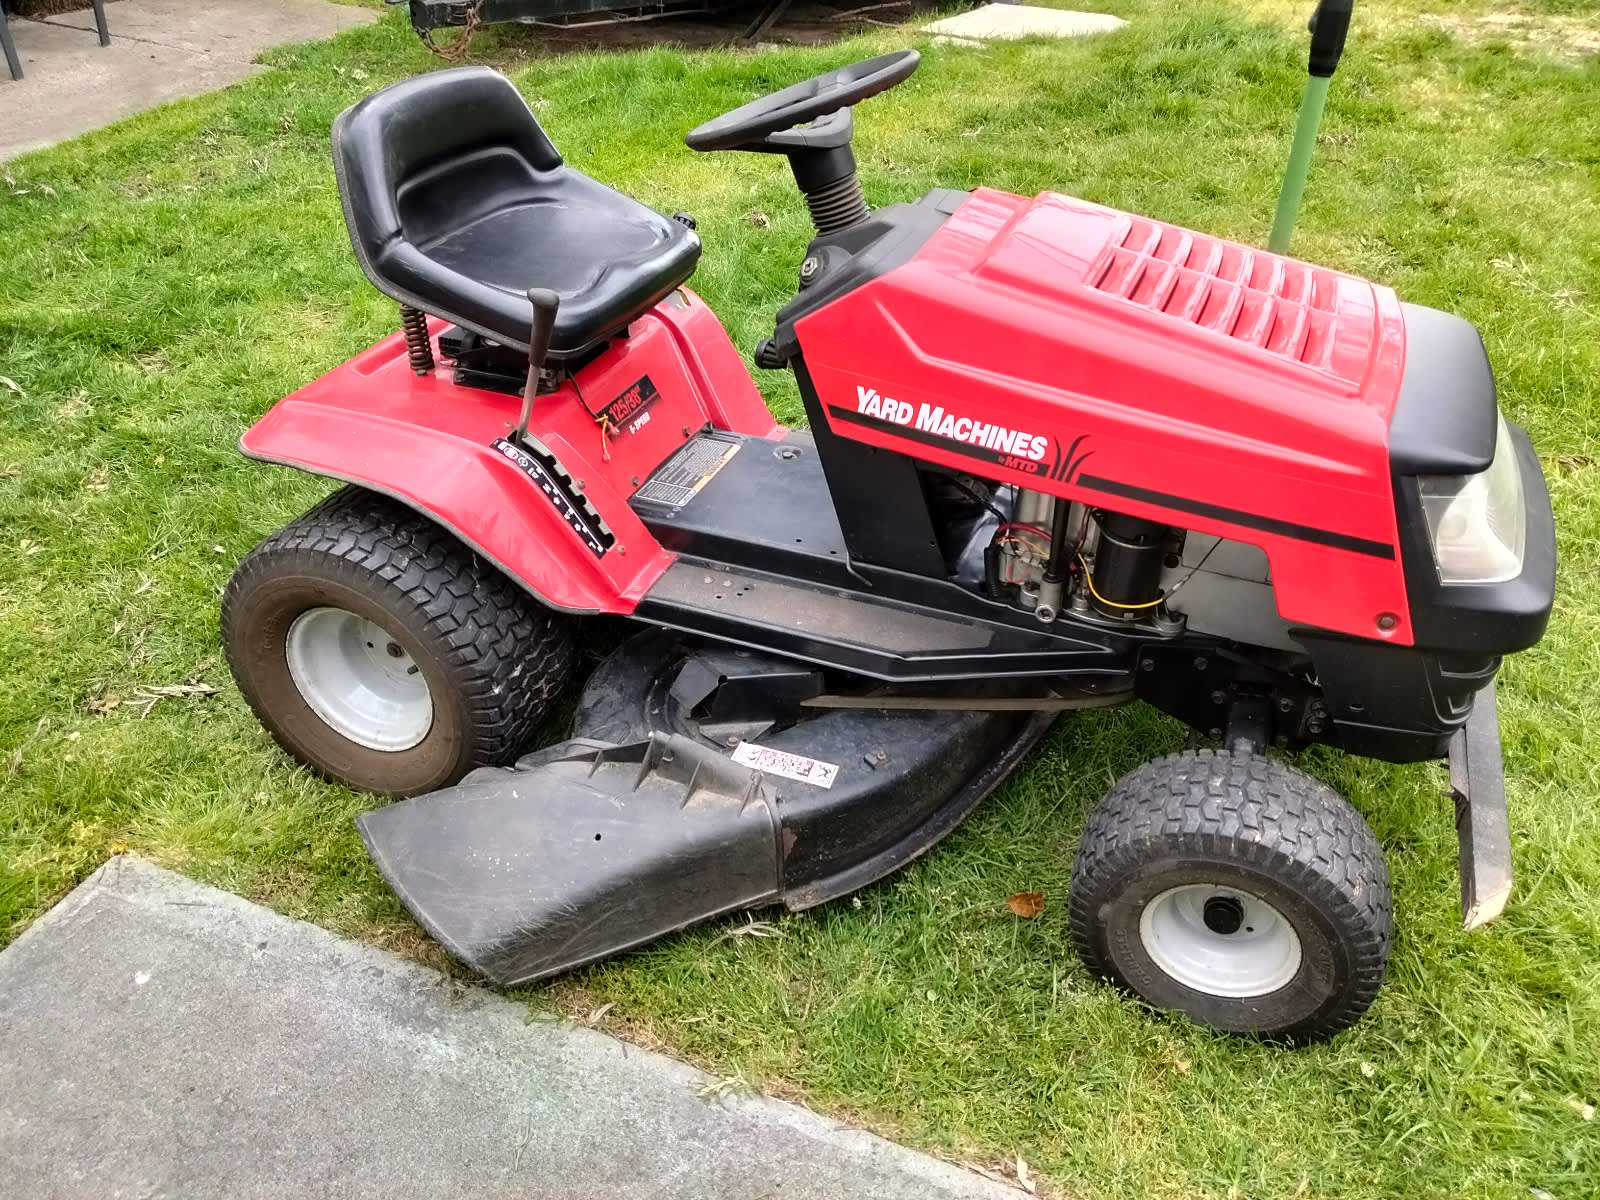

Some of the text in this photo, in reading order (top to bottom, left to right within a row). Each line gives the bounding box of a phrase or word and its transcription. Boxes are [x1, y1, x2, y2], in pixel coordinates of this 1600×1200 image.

[857, 386, 1048, 460] YARD MACHINES
[1005, 456, 1038, 473] MTD
